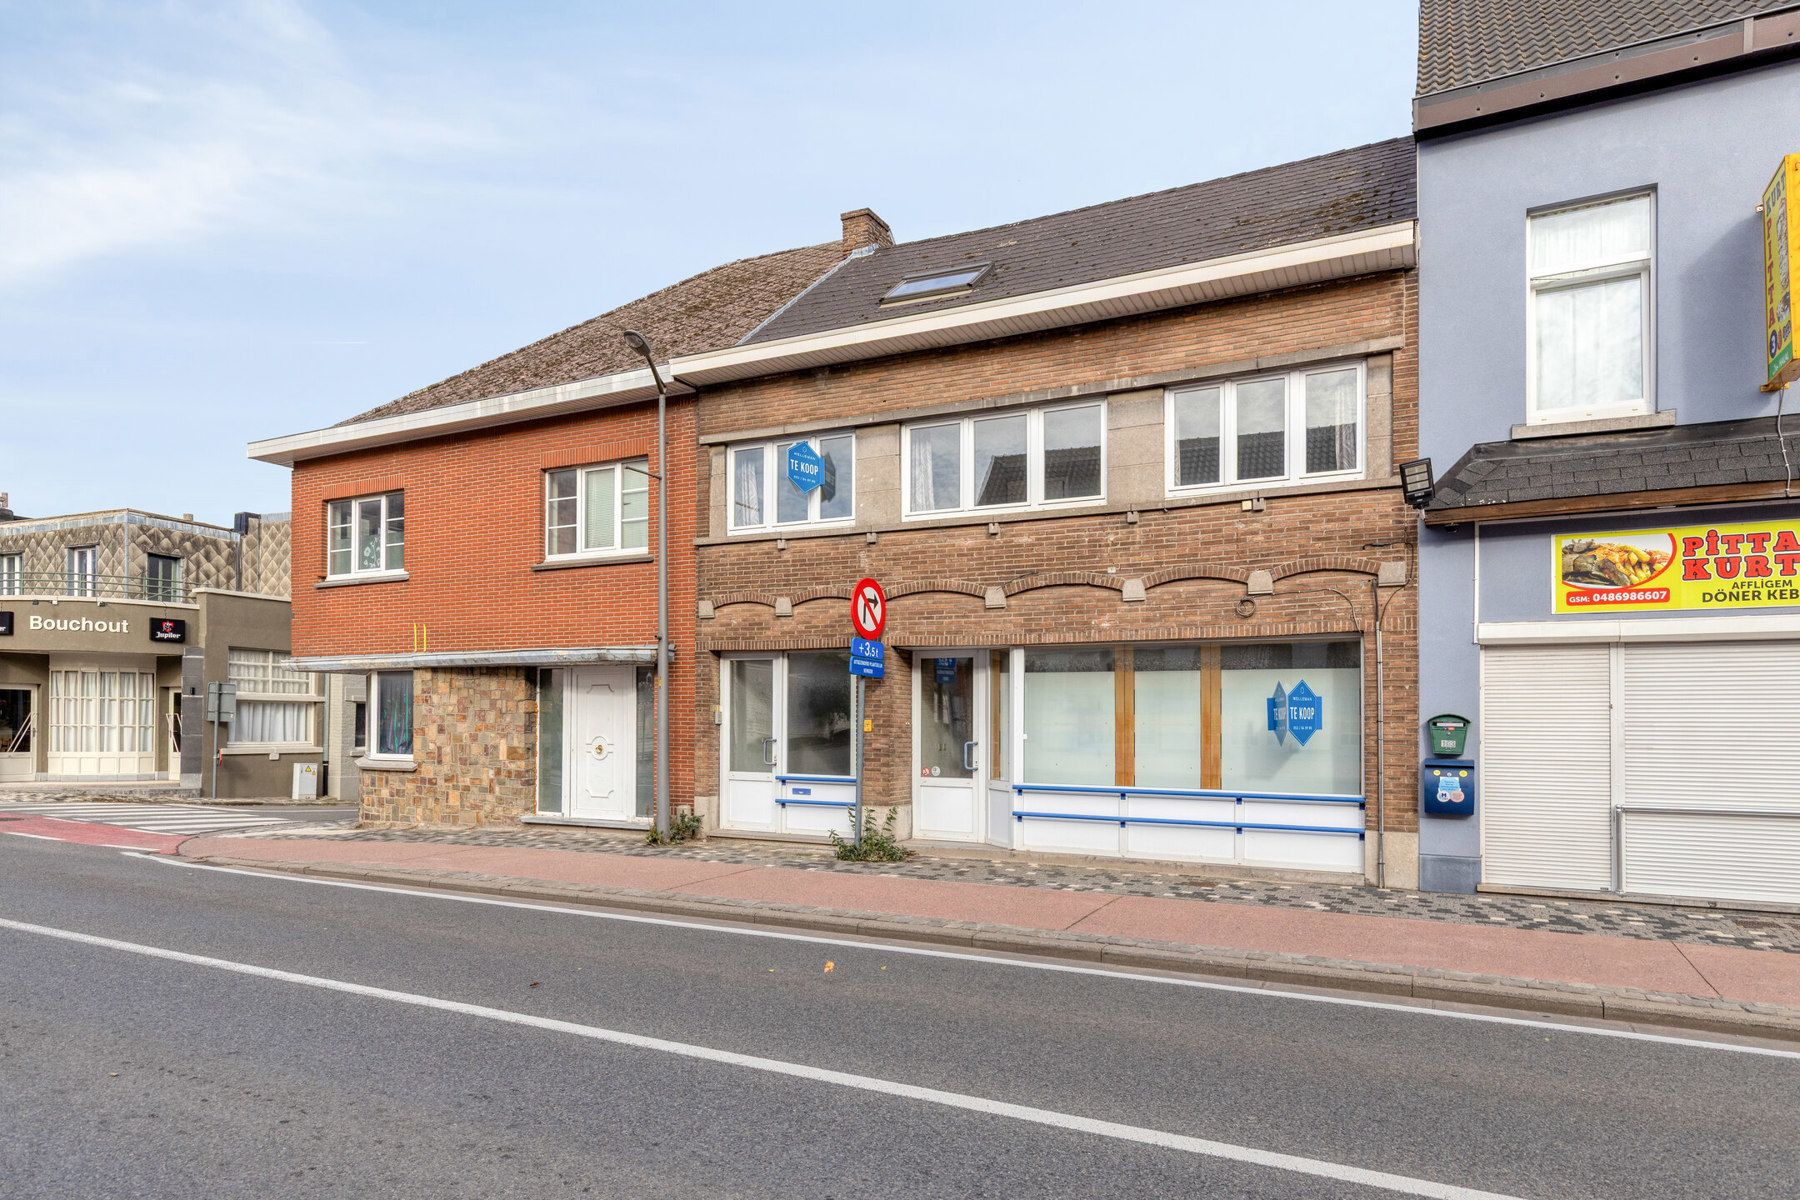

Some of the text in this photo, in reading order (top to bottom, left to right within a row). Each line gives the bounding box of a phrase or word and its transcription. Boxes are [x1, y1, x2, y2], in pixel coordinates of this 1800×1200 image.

[1766, 218, 1776, 329] PITTA
[790, 459, 818, 475] TE KOOP
[1682, 554, 1800, 581] KURT
[1592, 591, 1667, 602] 0486986607
[1702, 588, 1800, 603] DÖNER KEB
[29, 615, 129, 633] Bouchout
[155, 631, 181, 639] Jupiler
[1290, 707, 1314, 719] TE KOOP
